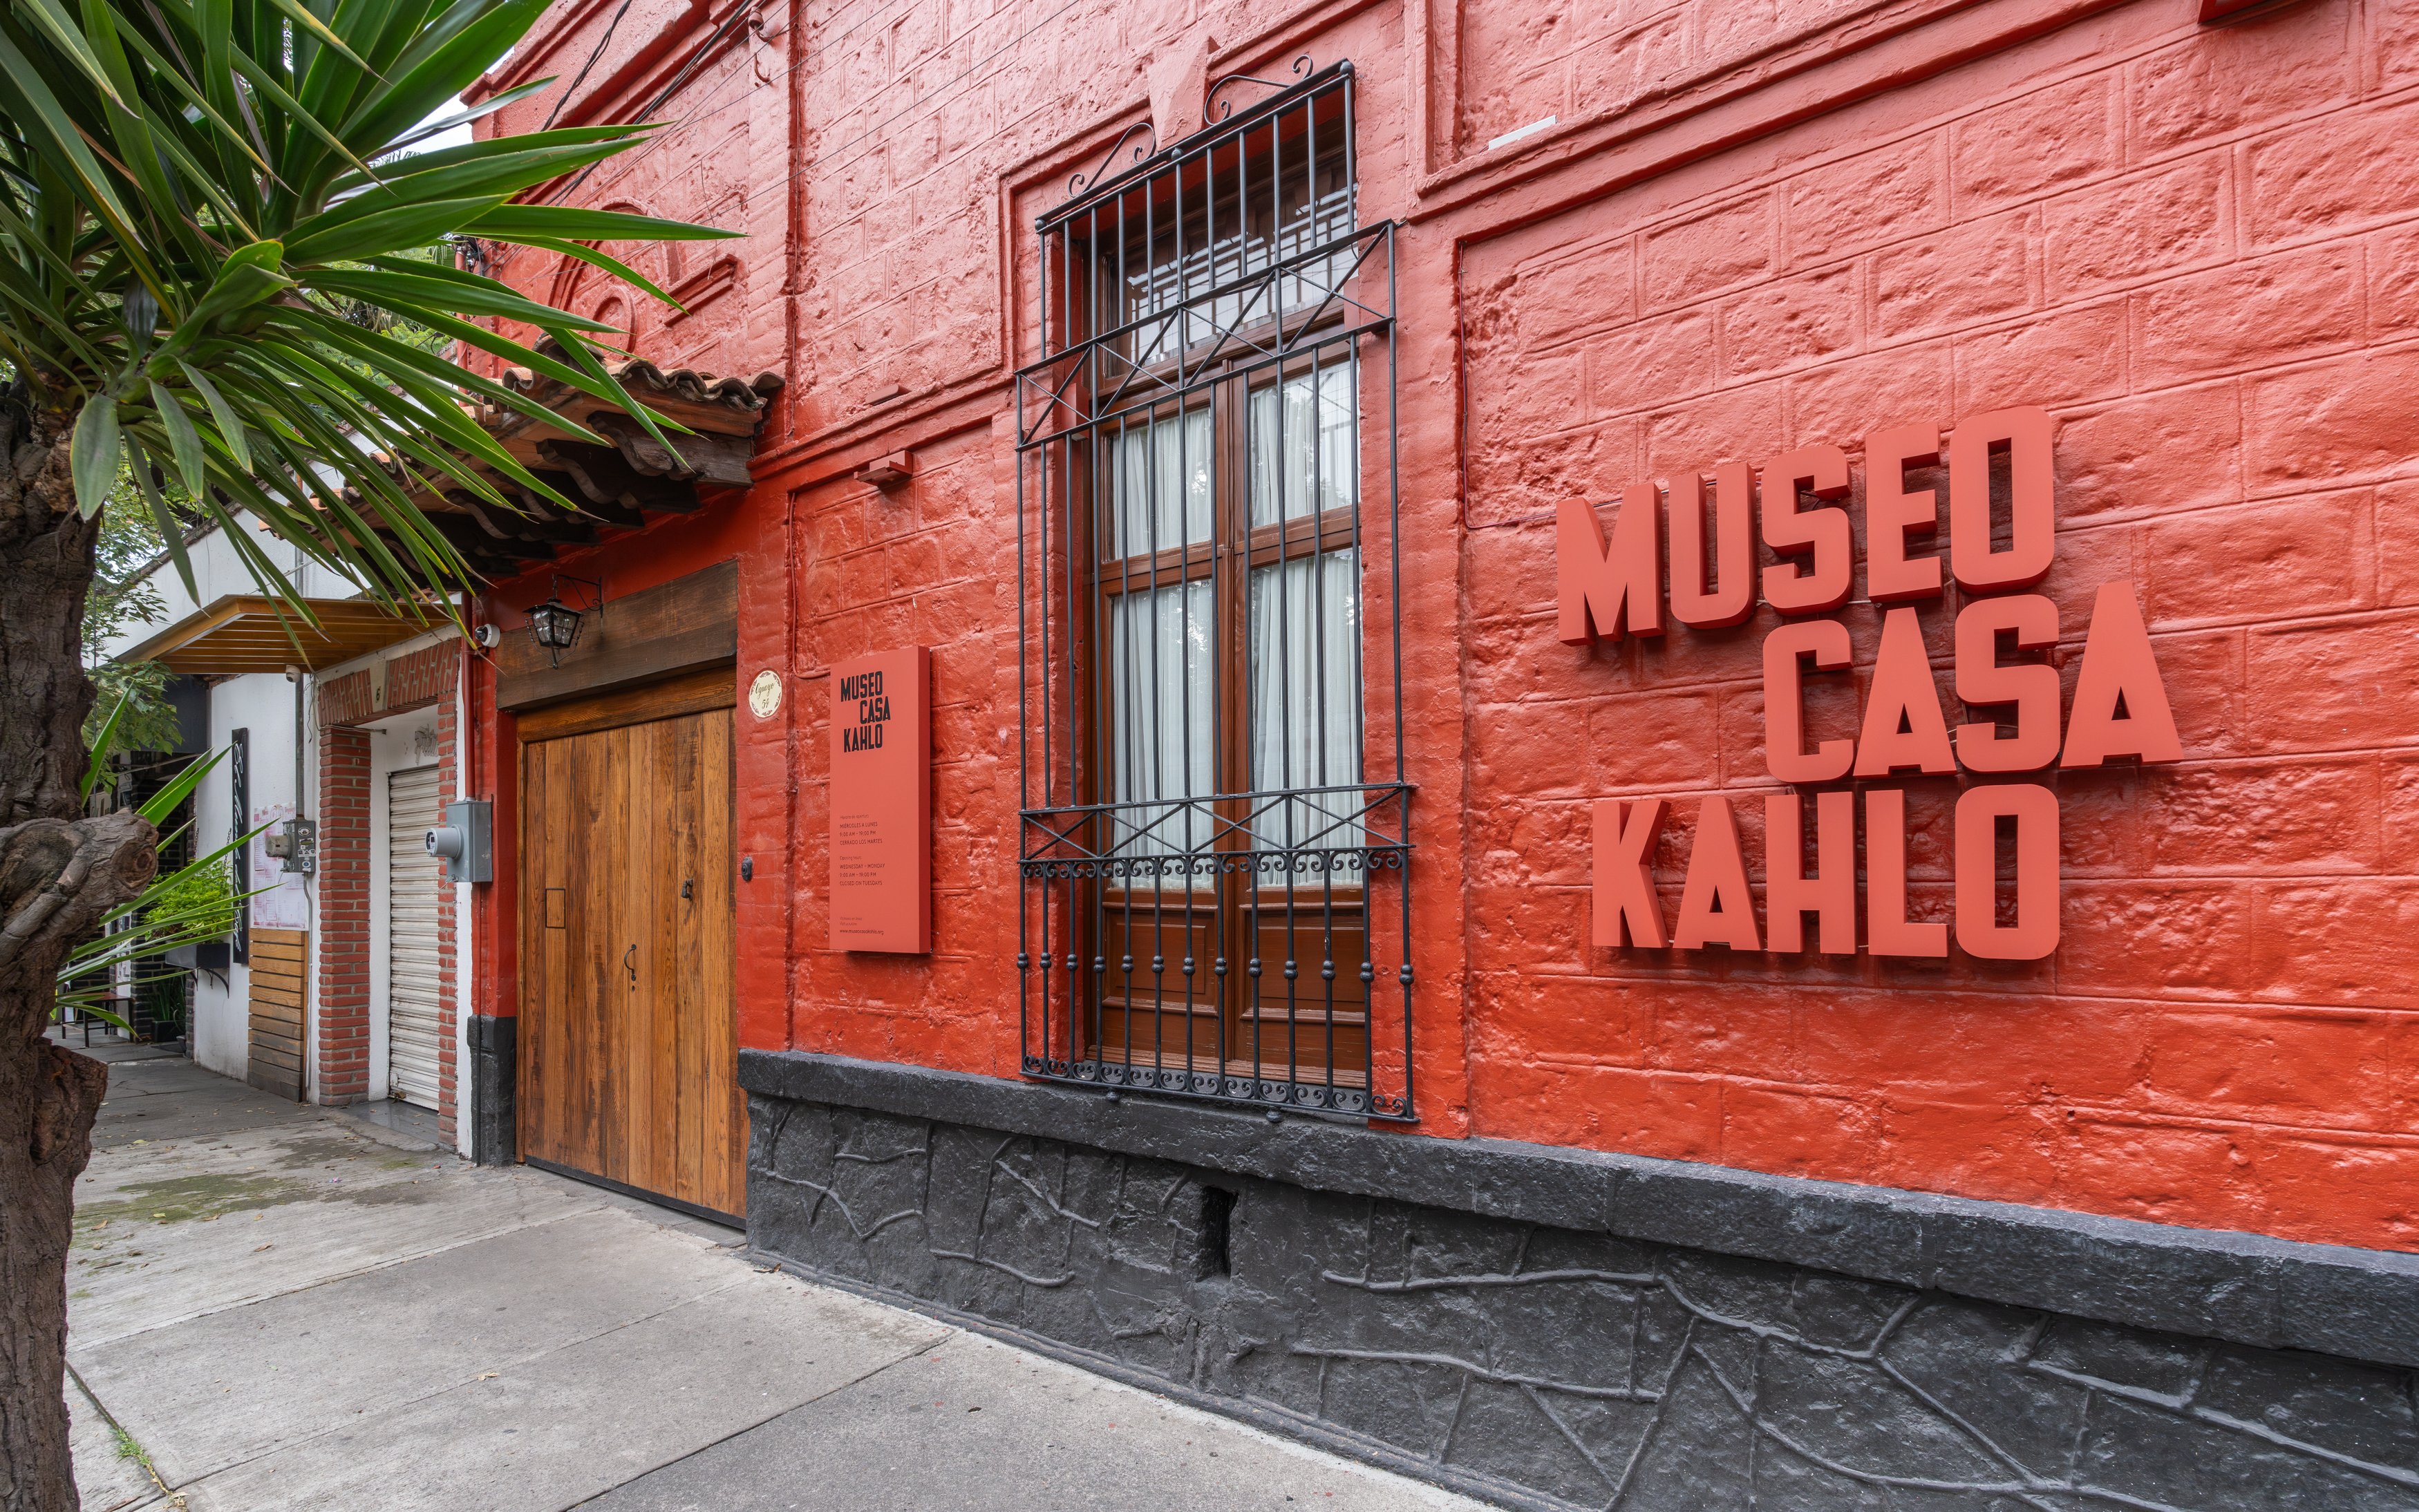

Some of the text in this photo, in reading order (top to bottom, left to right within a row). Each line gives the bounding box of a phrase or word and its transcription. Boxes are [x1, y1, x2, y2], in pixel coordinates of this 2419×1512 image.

[1556, 405, 2054, 647] MUSEO
[840, 670, 883, 702] MUSEO
[1762, 580, 2183, 782] CASA
[762, 698, 769, 709] 54
[859, 696, 891, 724] CASA
[843, 724, 883, 753] KAHLO
[1592, 783, 2060, 959] KAHLO
